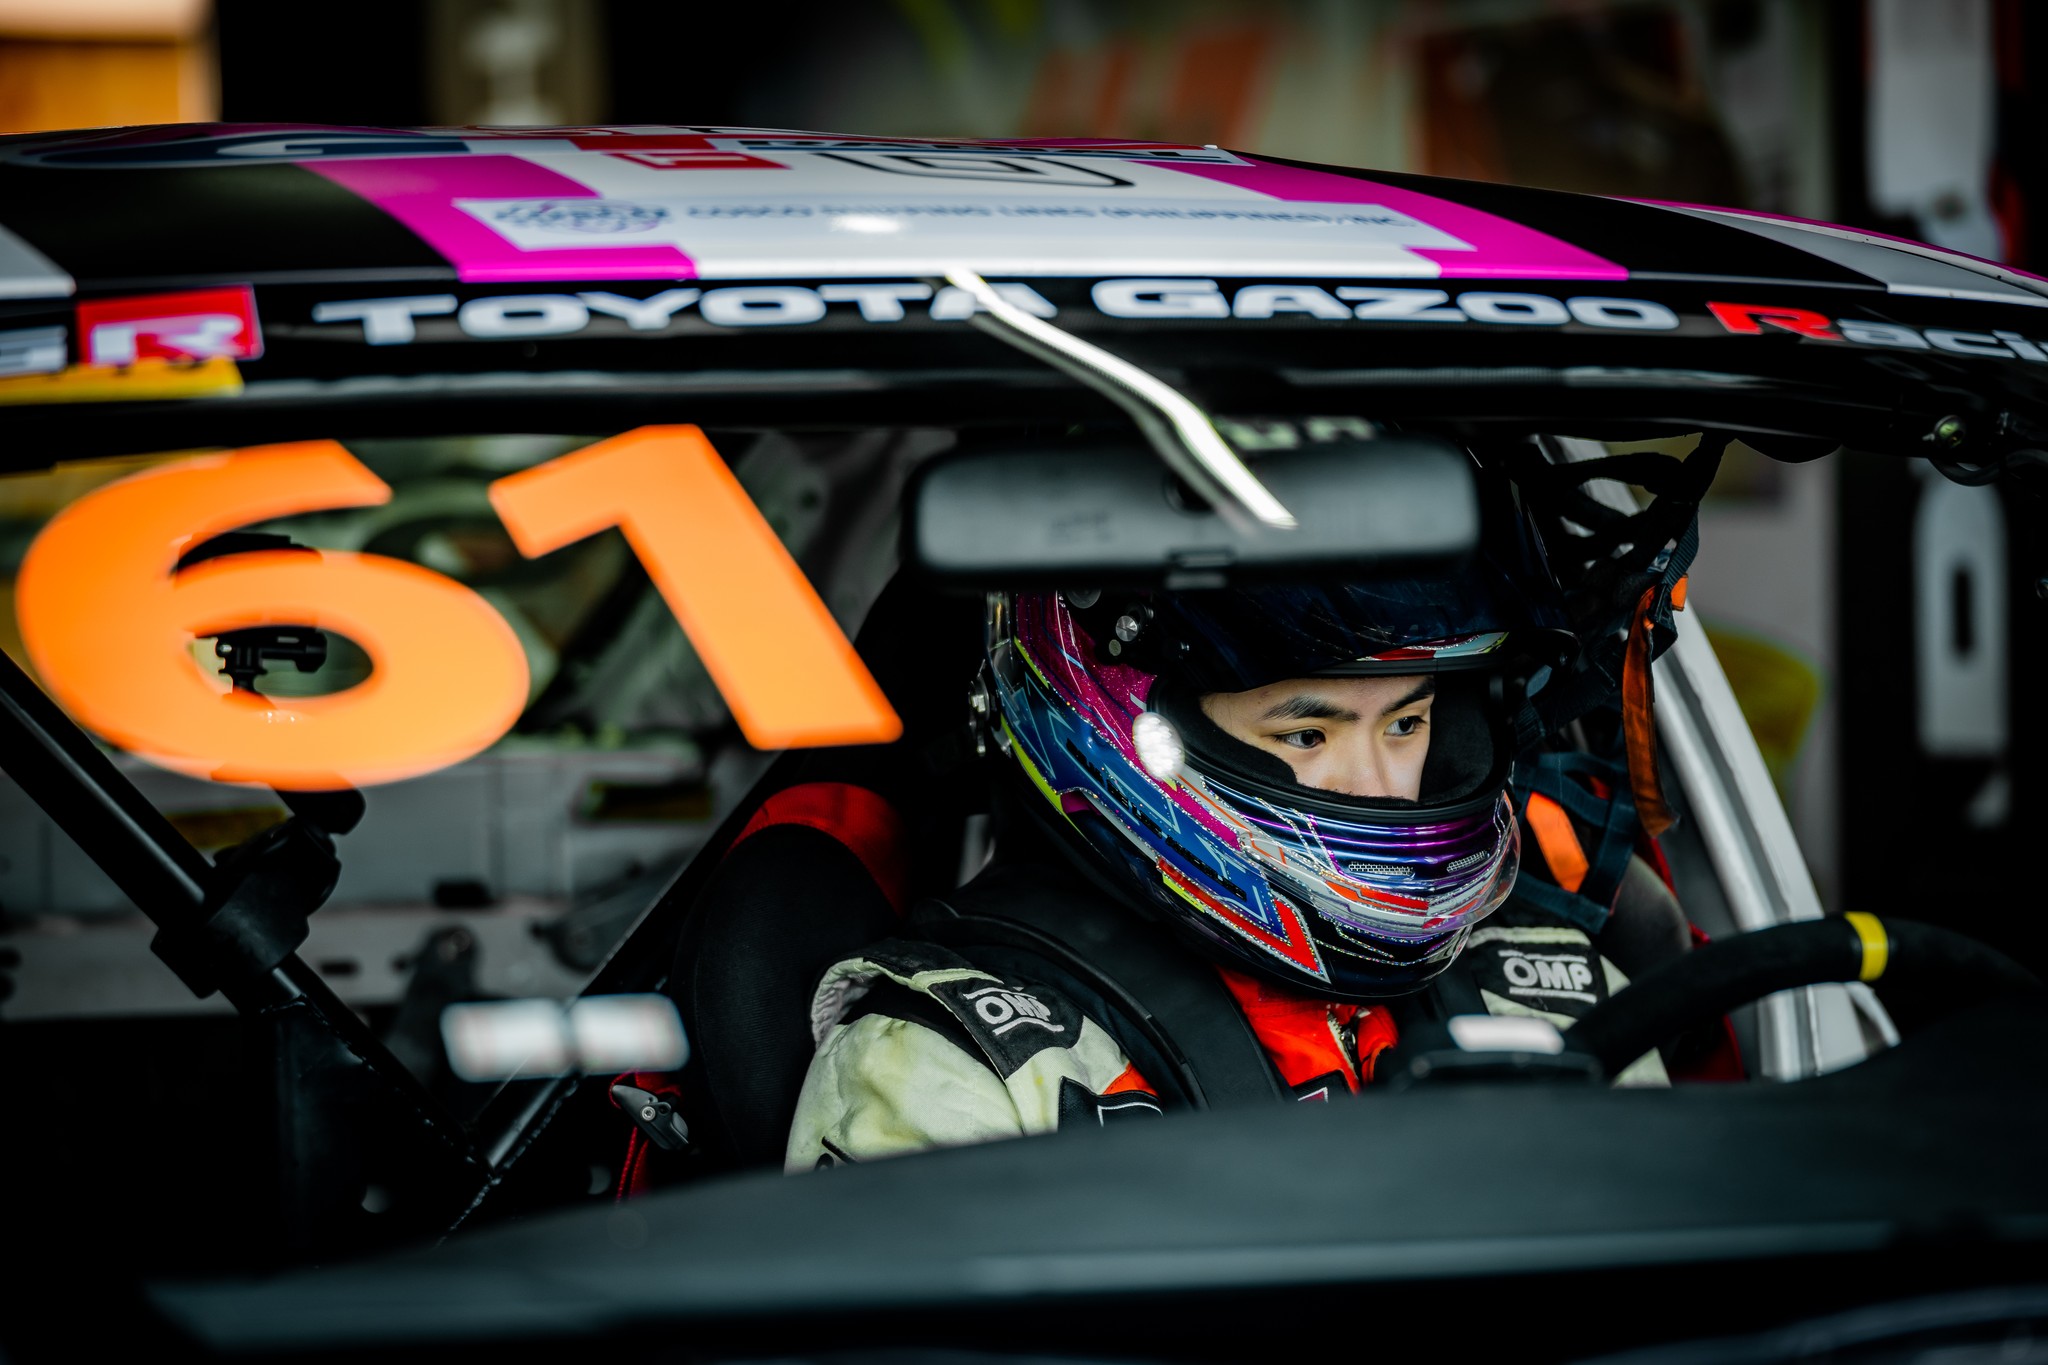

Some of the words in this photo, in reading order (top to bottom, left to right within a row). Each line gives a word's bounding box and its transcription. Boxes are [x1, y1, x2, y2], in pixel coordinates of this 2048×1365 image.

[312, 282, 1058, 345] TOYOTA
[1091, 278, 1680, 330] GAZOO
[1705, 301, 2048, 362] Raci
[16, 423, 904, 791] 61
[1503, 957, 1593, 991] OMP
[975, 993, 1051, 1025] OMP
